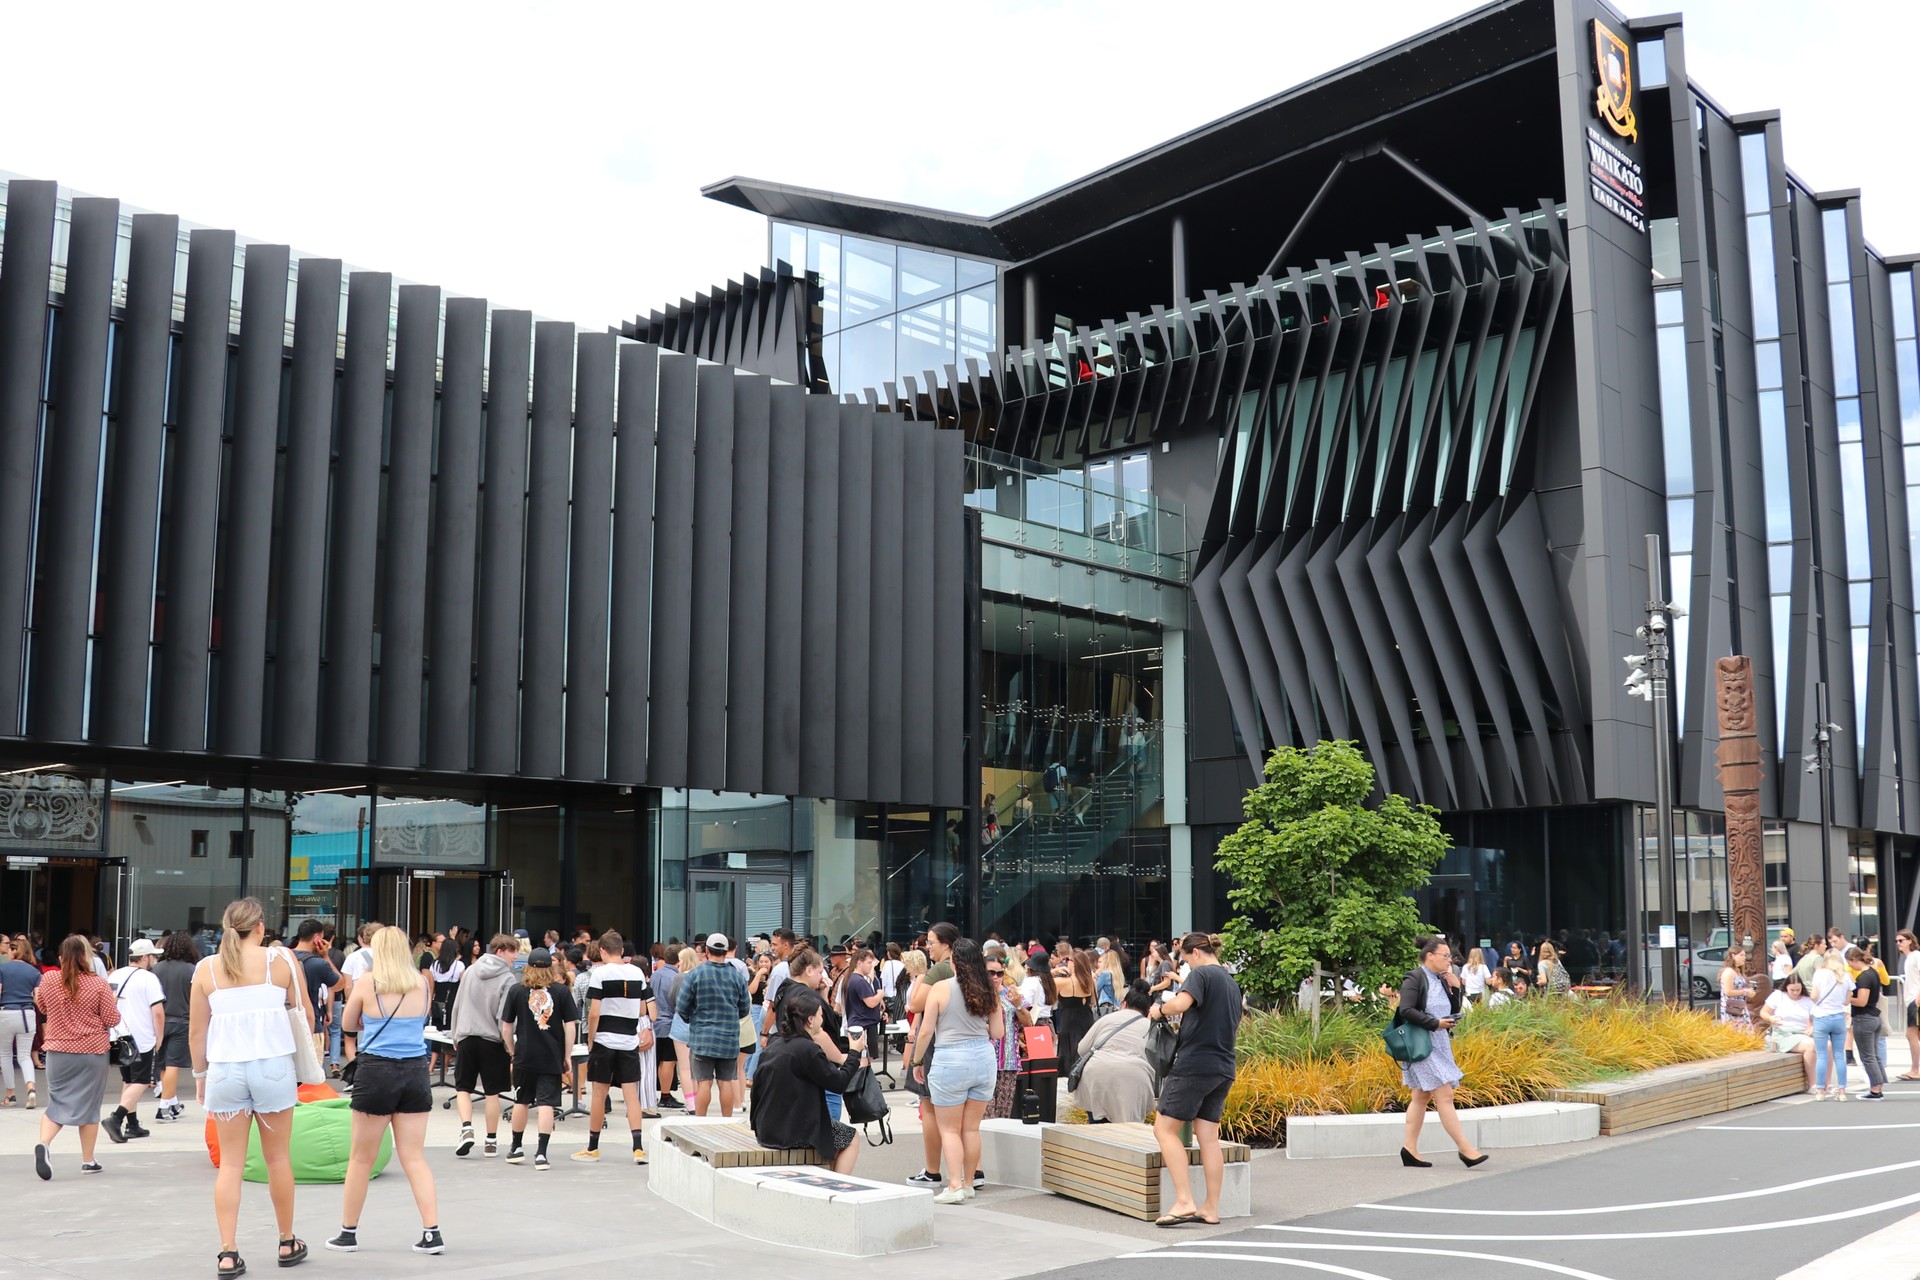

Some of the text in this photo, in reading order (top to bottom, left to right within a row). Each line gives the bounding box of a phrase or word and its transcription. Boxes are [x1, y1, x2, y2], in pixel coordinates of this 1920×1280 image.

[1588, 126, 1600, 141] THE
[1633, 163, 1641, 174] OF
[1588, 138, 1643, 195] WAIKATO
[1592, 184, 1646, 233] TAURANGA
